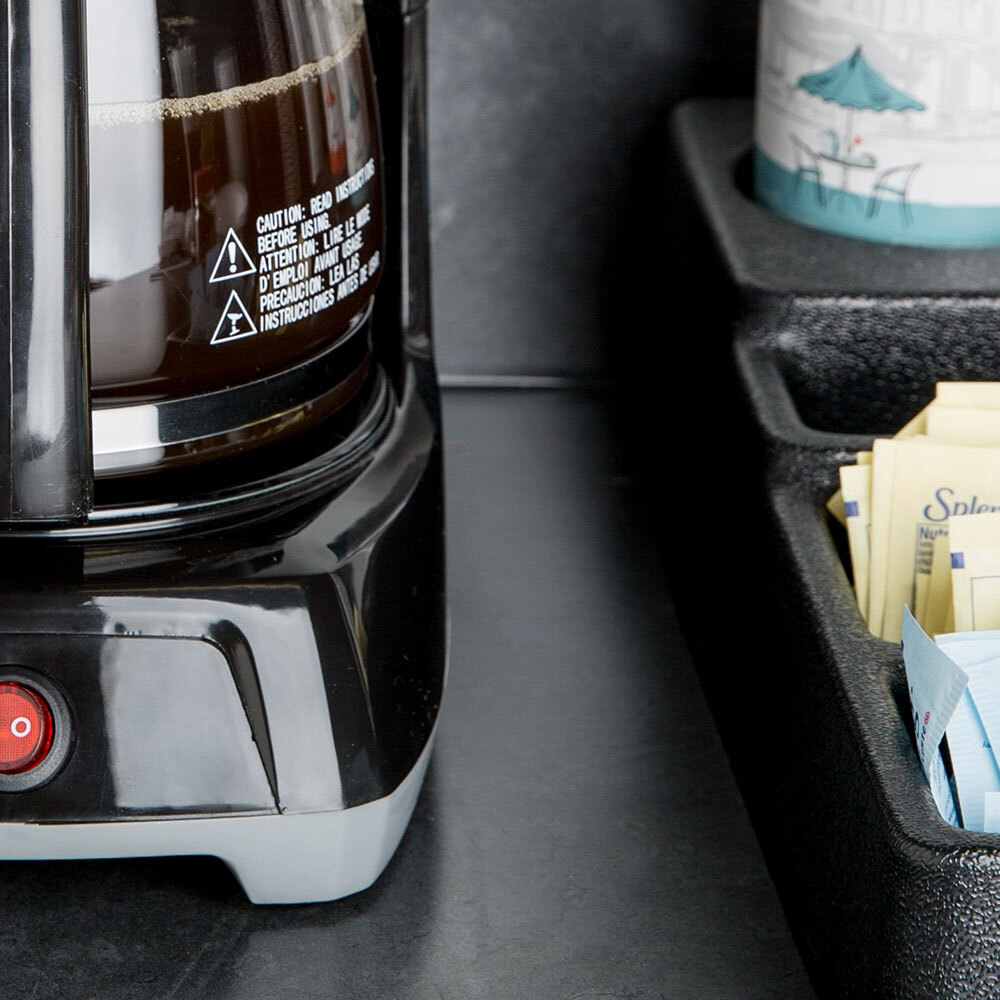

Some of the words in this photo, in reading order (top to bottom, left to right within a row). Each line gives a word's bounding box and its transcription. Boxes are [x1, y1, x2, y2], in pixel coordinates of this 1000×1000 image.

[256, 203, 306, 234] CAUTION:
[310, 191, 333, 216] READ
[257, 225, 298, 254] BEFORE
[259, 238, 320, 274] ATTENTION:
[323, 224, 344, 250] LIRE
[345, 216, 356, 237] LE
[314, 246, 340, 275] AVANT
[260, 275, 326, 313] PRECAUCION:
[329, 263, 345, 287] LEA
[346, 252, 360, 277] LAS
[260, 288, 335, 333] INSTRUCCIONES
